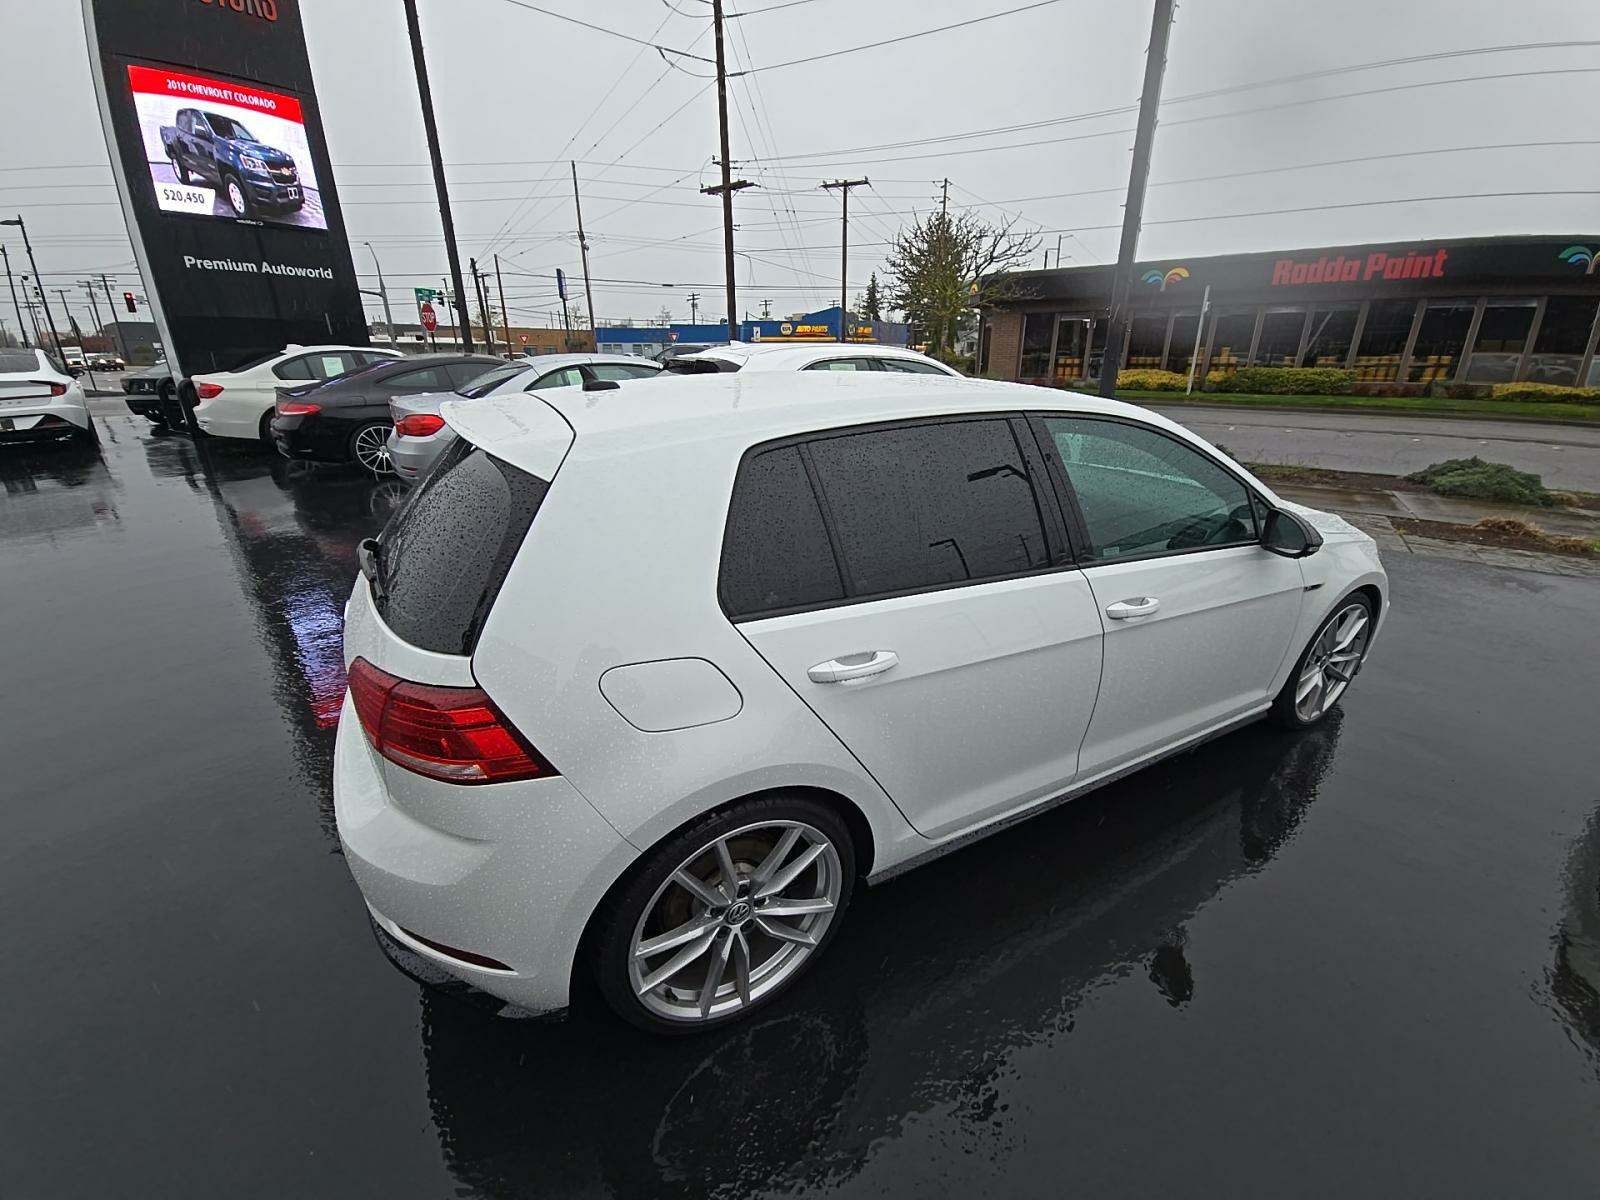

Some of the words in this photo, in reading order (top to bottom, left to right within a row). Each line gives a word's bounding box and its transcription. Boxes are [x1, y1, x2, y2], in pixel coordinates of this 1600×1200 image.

[166, 79, 187, 92] 2019
[187, 83, 233, 101] CHEVROLET
[234, 93, 277, 110] COLORADO
[163, 189, 205, 204] $20,450
[183, 255, 258, 273] Premium
[261, 261, 334, 280] Autoworld
[1271, 256, 1362, 288] Rodda
[1363, 249, 1448, 281] Paint
[421, 312, 436, 324] STOP
[795, 325, 812, 333] AUTO
